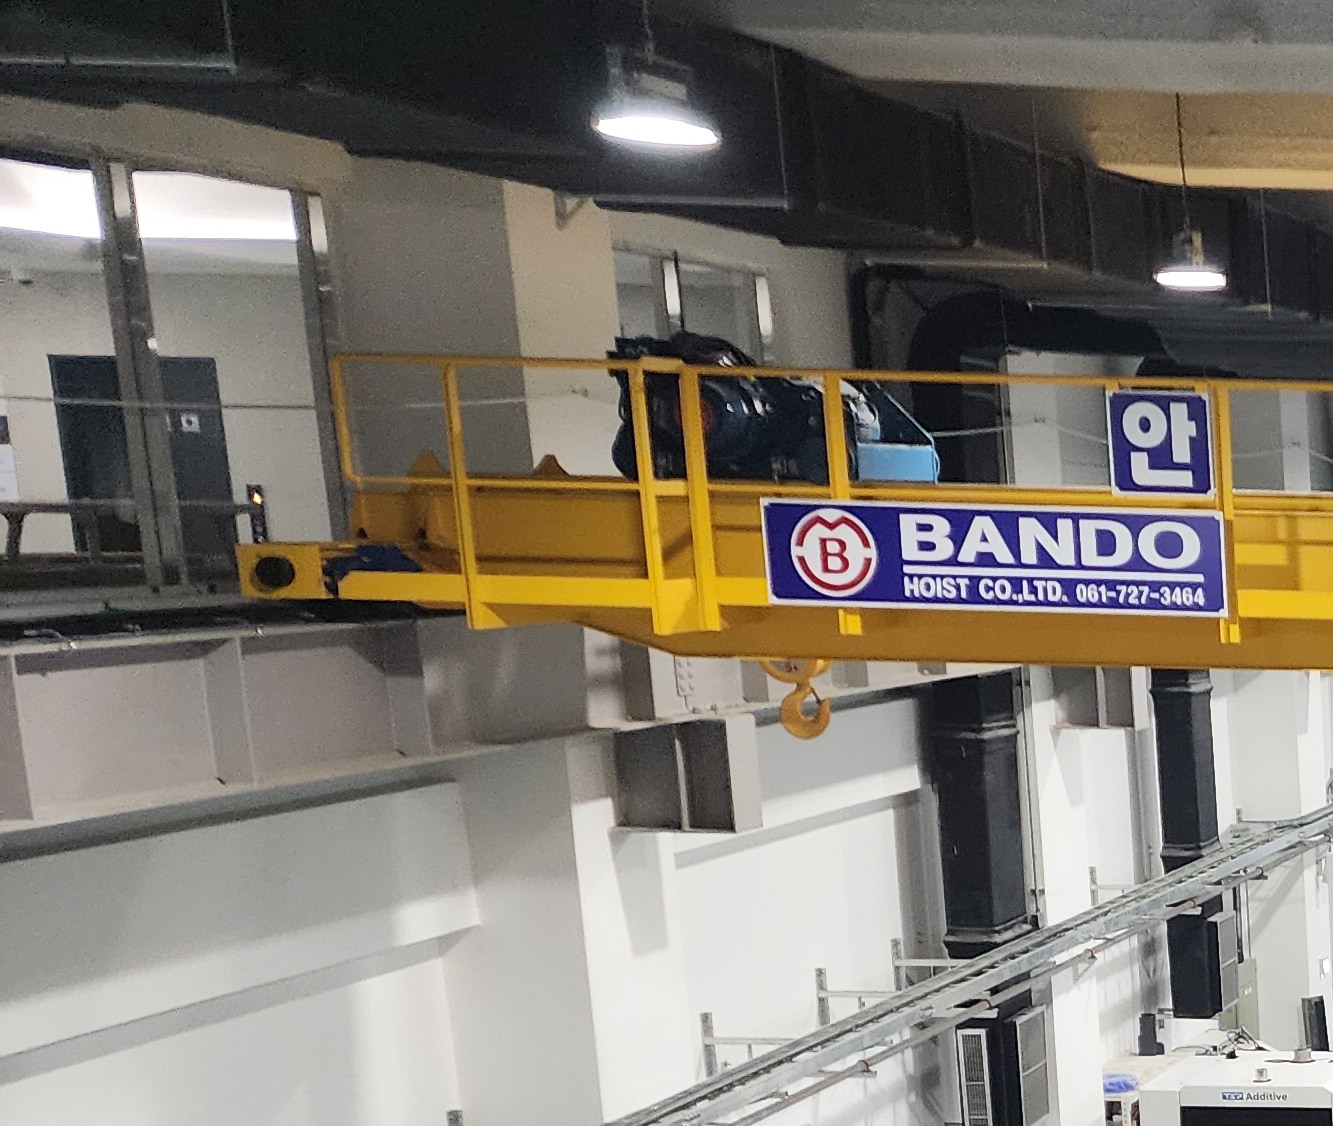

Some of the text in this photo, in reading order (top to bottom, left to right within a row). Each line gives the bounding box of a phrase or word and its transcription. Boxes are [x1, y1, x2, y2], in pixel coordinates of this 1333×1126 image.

[1122, 400, 1197, 488] 안
[899, 512, 1202, 570] BANDO
[903, 575, 969, 600] HOIST
[1075, 582, 1206, 607] 061-727-3464
[1245, 1092, 1288, 1101] Additive
